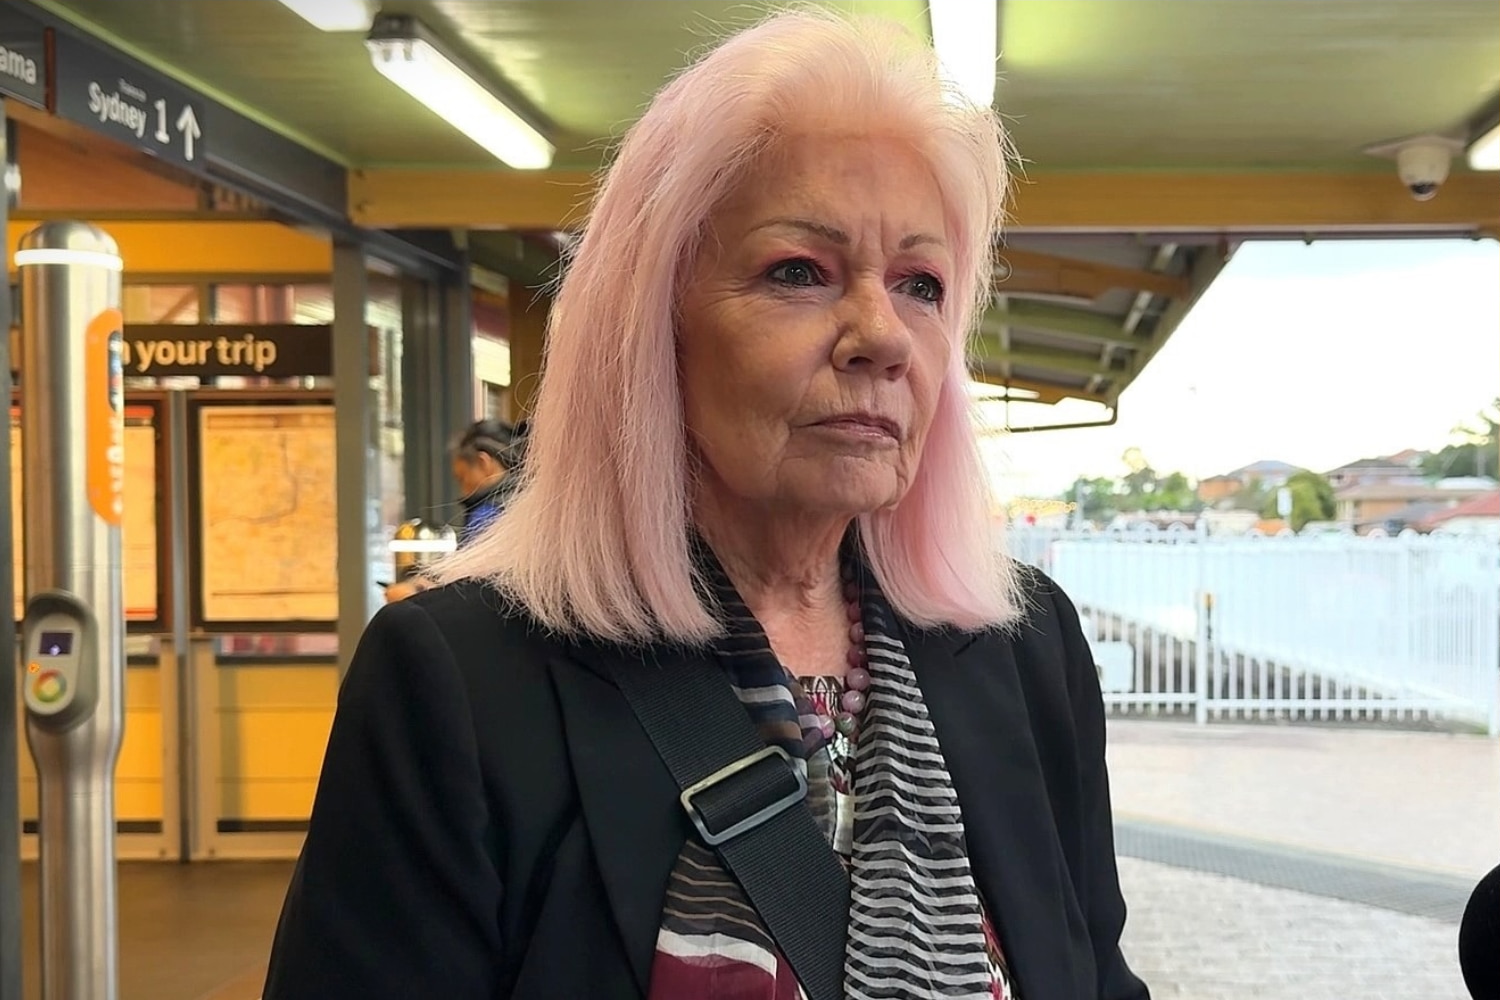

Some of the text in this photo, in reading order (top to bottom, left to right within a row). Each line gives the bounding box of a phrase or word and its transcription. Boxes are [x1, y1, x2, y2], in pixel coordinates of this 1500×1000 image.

[88, 81, 148, 139] Sydney
[154, 98, 170, 144] 1
[134, 339, 213, 373] your
[215, 333, 278, 373] trip
